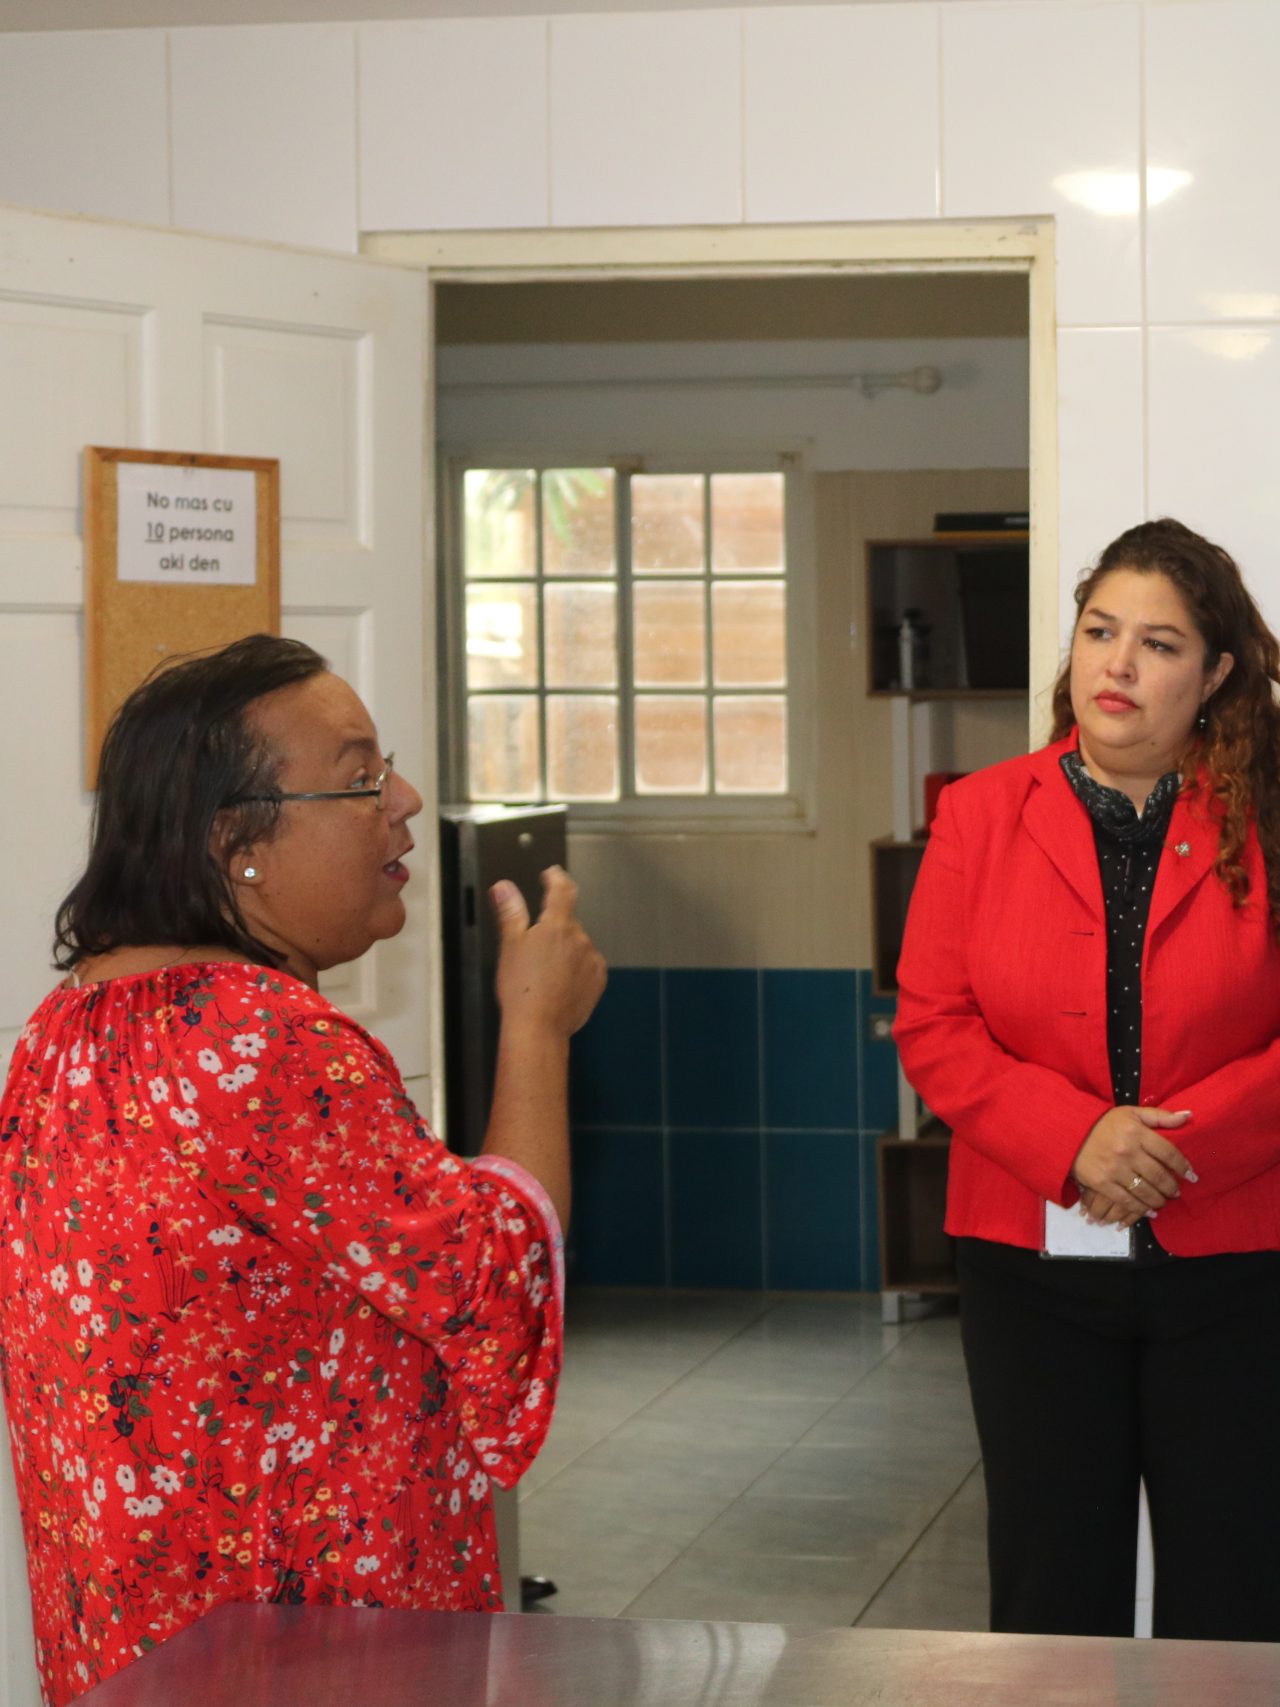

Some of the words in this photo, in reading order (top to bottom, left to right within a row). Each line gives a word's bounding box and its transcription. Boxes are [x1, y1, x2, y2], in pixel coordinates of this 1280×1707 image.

[147, 491, 170, 509] No
[175, 496, 208, 511] mas
[212, 498, 233, 512] cu
[146, 522, 164, 542] 10
[169, 526, 234, 543] persona
[159, 553, 185, 571] aki
[189, 554, 220, 571] den
